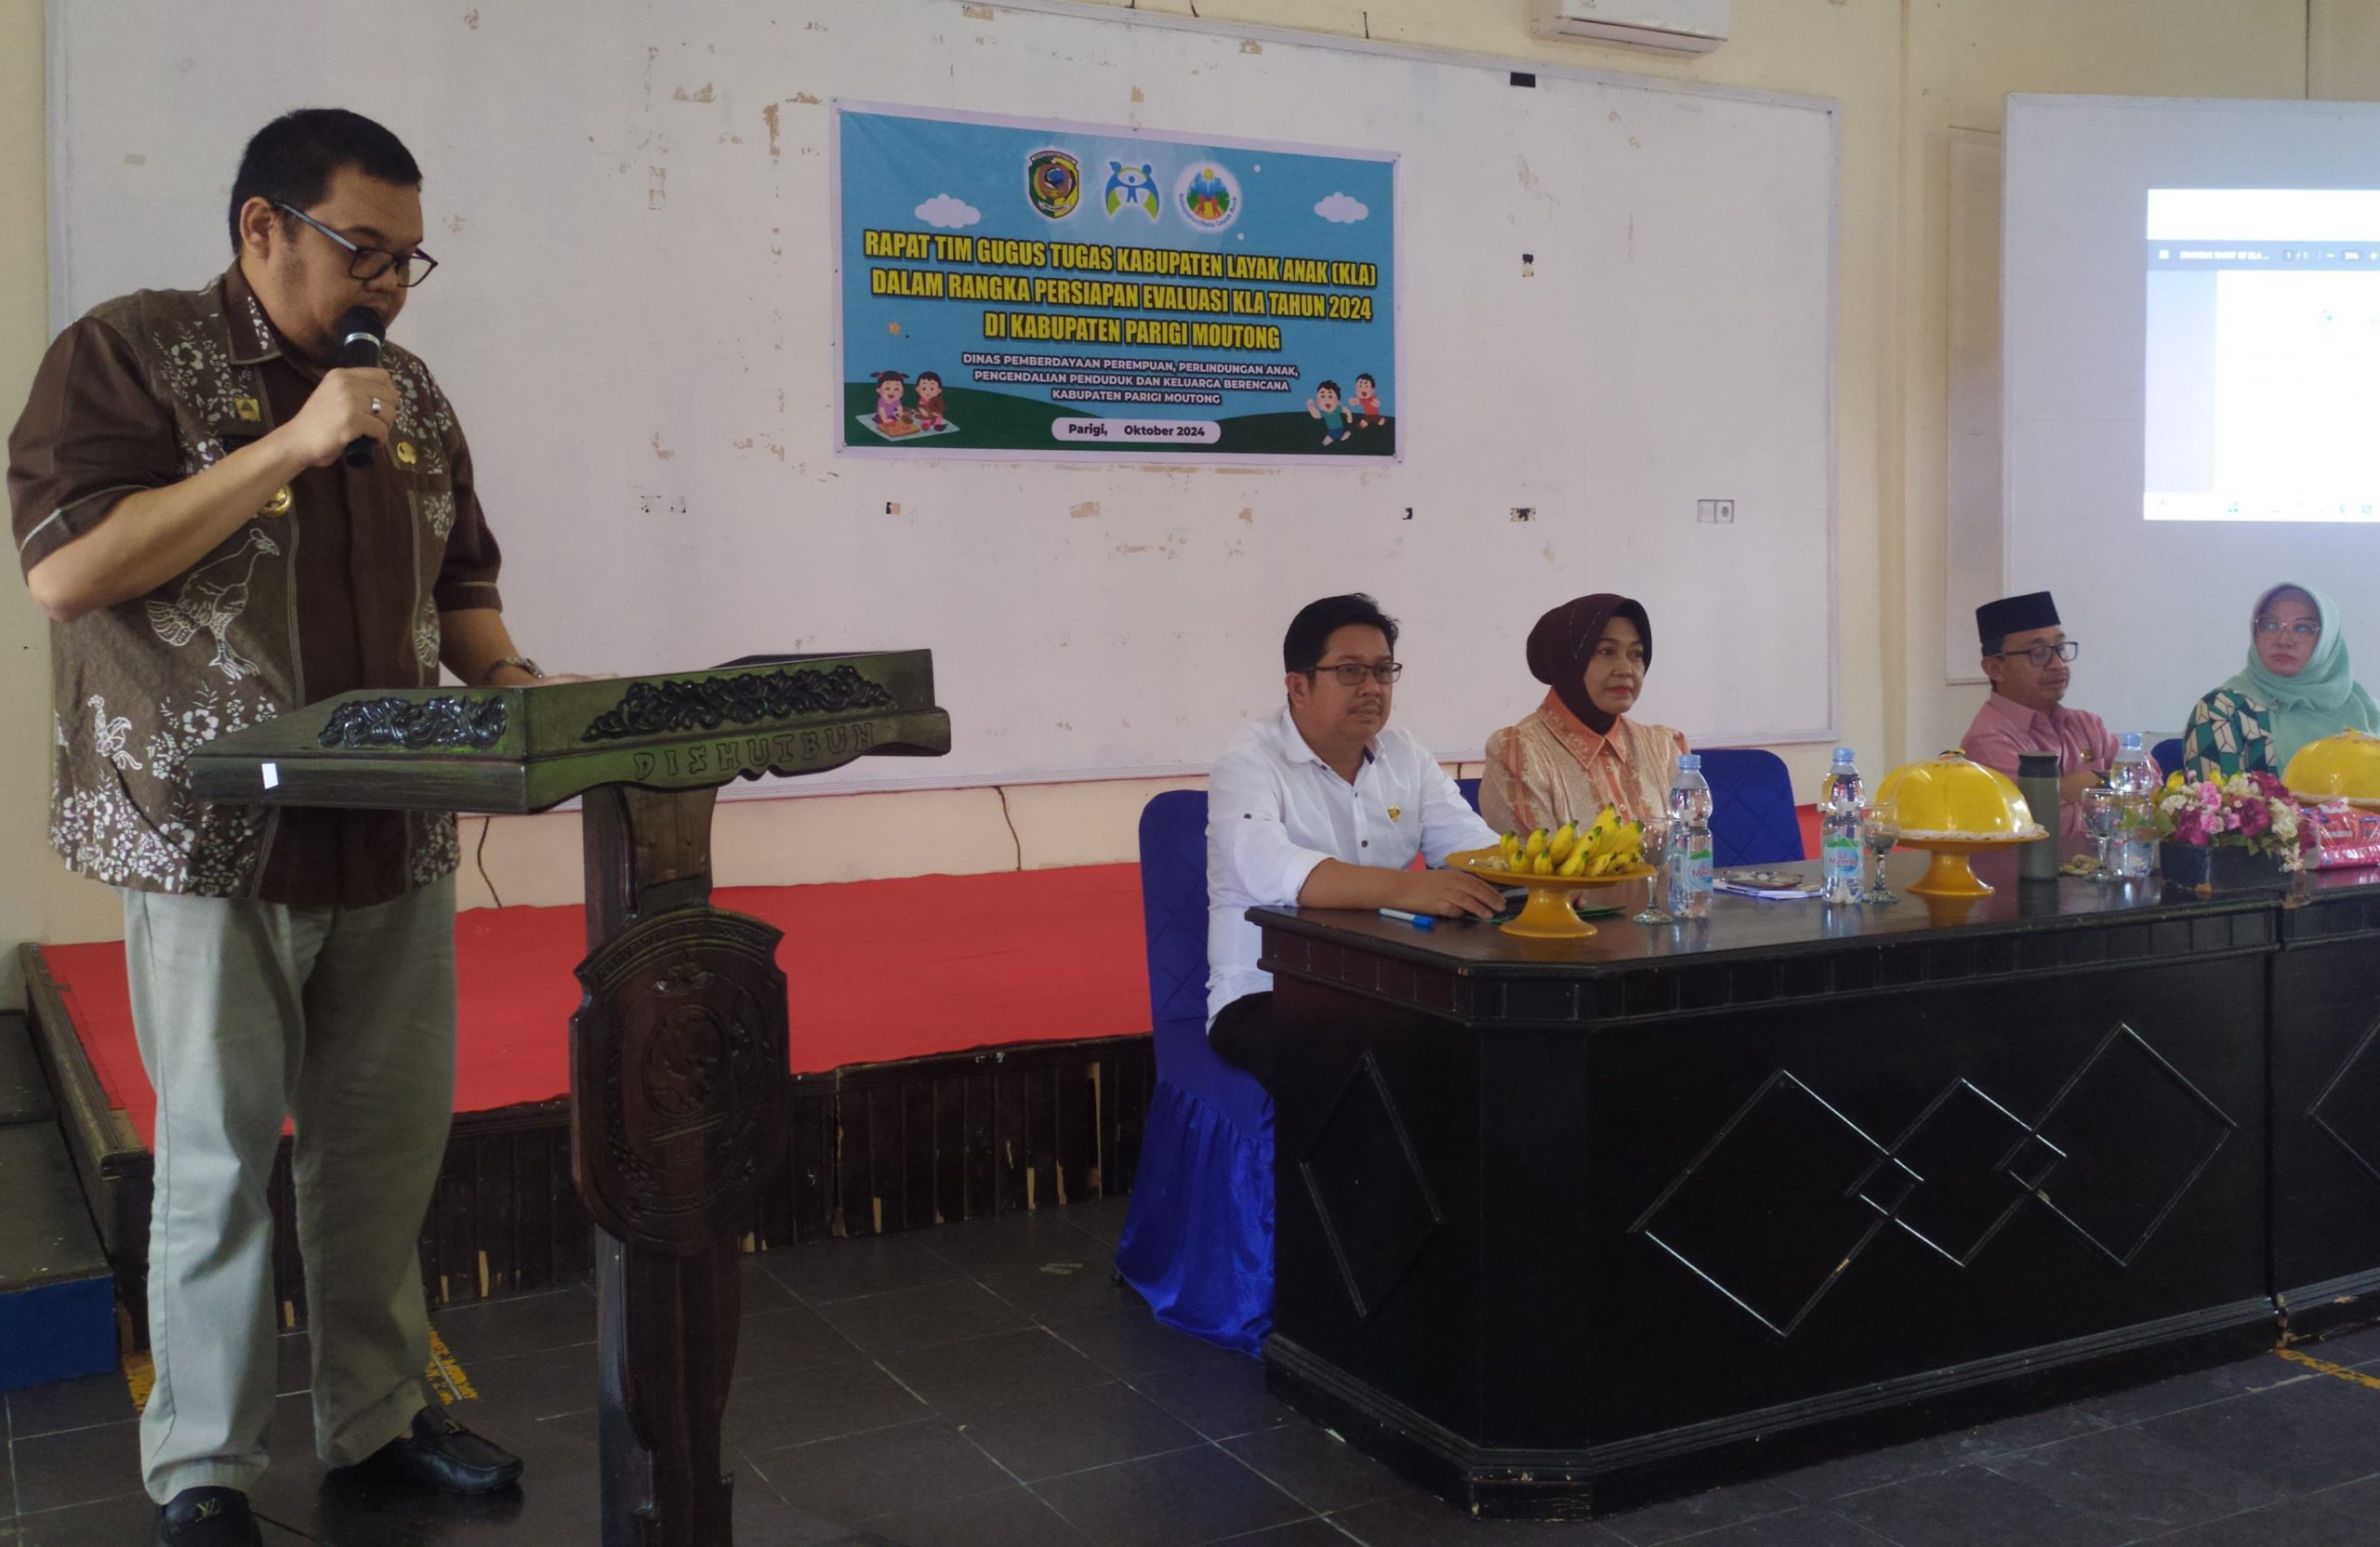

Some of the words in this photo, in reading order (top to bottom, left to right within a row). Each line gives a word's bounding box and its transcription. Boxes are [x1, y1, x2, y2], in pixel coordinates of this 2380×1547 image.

[865, 231, 931, 259] RAPAT
[934, 235, 973, 262] TIM
[977, 238, 1047, 268] GUGUS
[1050, 244, 1114, 271] TUGAS
[1117, 248, 1223, 278] KABUPATEN
[1226, 255, 1281, 282] LAYAK
[1282, 258, 1329, 284] ANAK
[1331, 262, 1378, 287] (KLA)
[871, 269, 944, 298] DALAM
[947, 273, 1031, 303] RANGKA
[1034, 279, 1139, 309] PERSIAPAN
[1144, 284, 1229, 312] EVALUASI
[1233, 289, 1266, 314] KLA
[1268, 291, 1327, 318] TAHUN
[1328, 295, 1373, 320] 2024
[984, 311, 1007, 338] DI
[1011, 313, 1121, 343] KABUPATEN
[1125, 319, 1188, 347] PARIGI
[1192, 322, 1282, 350] MOUTONG
[962, 353, 1001, 364] DINAS
[1003, 355, 1101, 369] PEMBERDAYAAN
[1104, 359, 1177, 373] PEREMPUAN,
[1179, 362, 1264, 376] PERLINDUNGAN
[1265, 365, 1300, 377] ANAK,
[974, 371, 1067, 383] PENGENDALIAN
[1070, 374, 1134, 386] PENDUDUK
[1136, 377, 1161, 387] DAN
[1163, 377, 1223, 389] KELUARGA
[1223, 380, 1289, 391] BERENCANA
[1051, 389, 1122, 402] KABUPATEN
[1124, 391, 1162, 403] PARIGI
[1164, 393, 1222, 404] MOUTONG
[1068, 424, 1108, 437] Parigi,
[1124, 425, 1174, 436] Oktober
[1177, 427, 1206, 437] 2024
